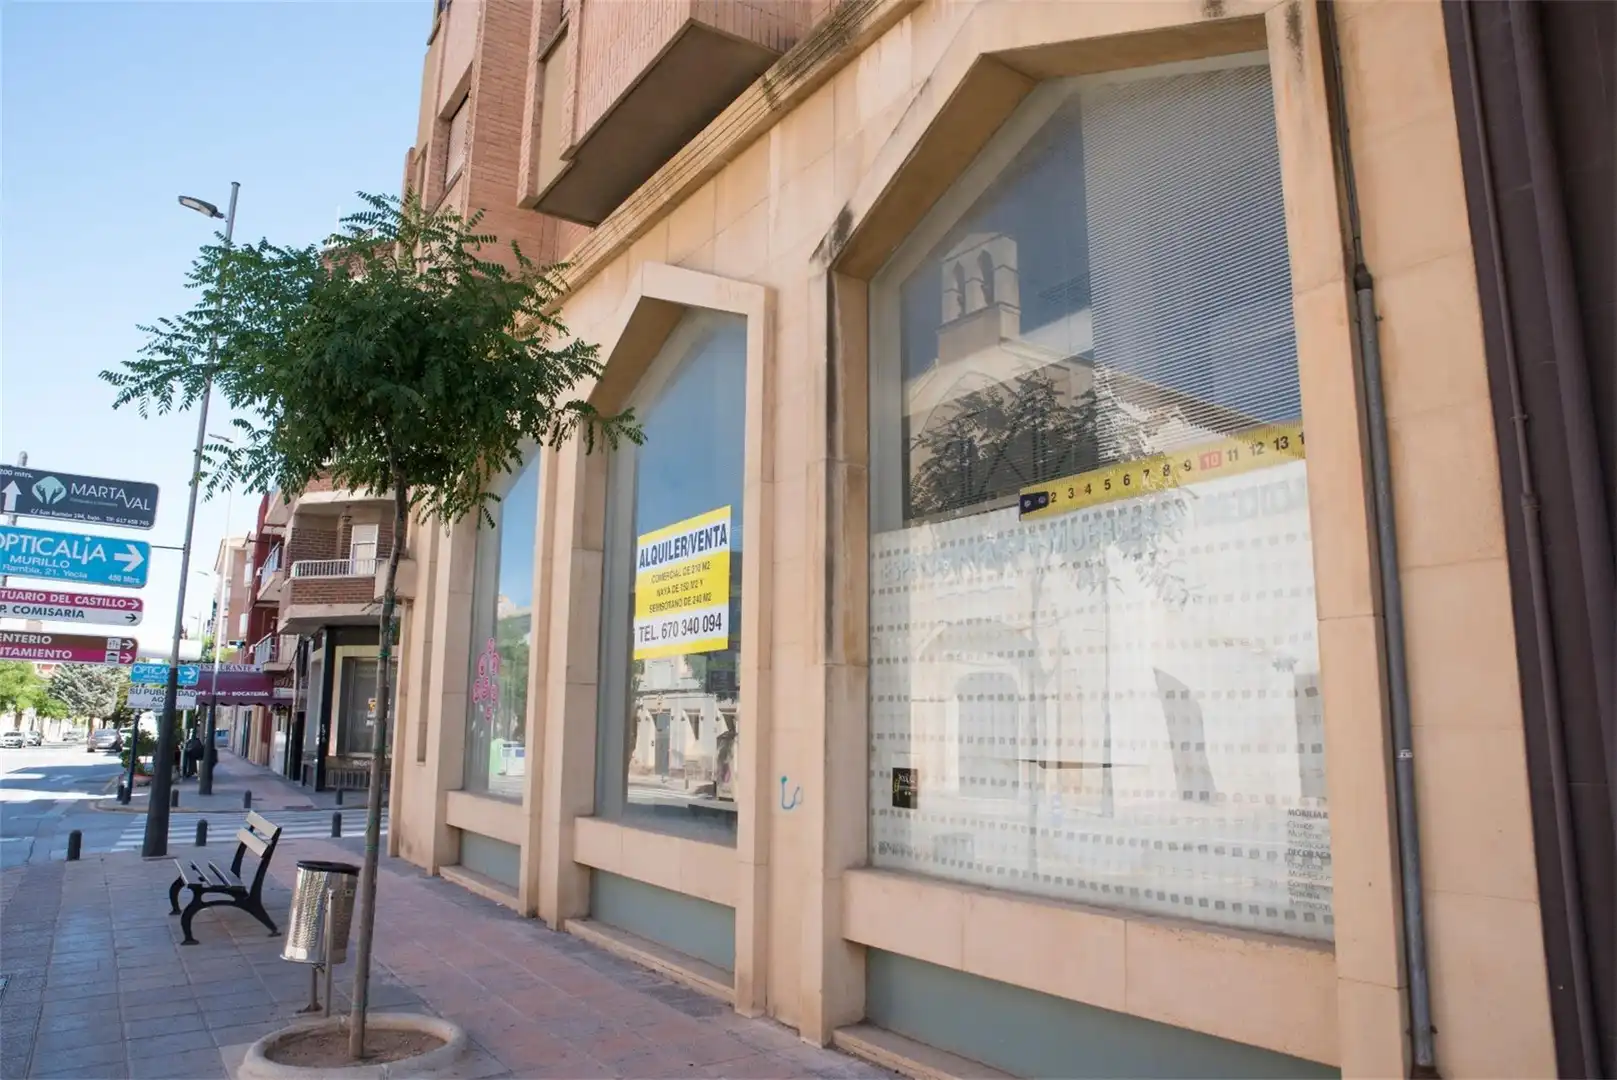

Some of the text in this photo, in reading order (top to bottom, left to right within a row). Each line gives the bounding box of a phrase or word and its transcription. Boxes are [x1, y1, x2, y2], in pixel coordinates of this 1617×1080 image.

[1050, 491, 1057, 503] 2
[1067, 487, 1074, 499] 3
[1084, 483, 1092, 495] 4
[1104, 478, 1111, 490] 5
[1123, 473, 1131, 486] 6
[1162, 463, 1170, 477] 8
[1183, 459, 1192, 472] 9
[1227, 446, 1239, 461] 11
[1249, 441, 1265, 456] 12
[1273, 435, 1289, 451] 13
[9, 554, 70, 569] MURILLO
[639, 523, 728, 569] ALQUILER/VENTA
[50, 593, 71, 604] DEL
[75, 597, 127, 608] CASTILLO
[639, 612, 722, 643] TEL. 670 340 094
